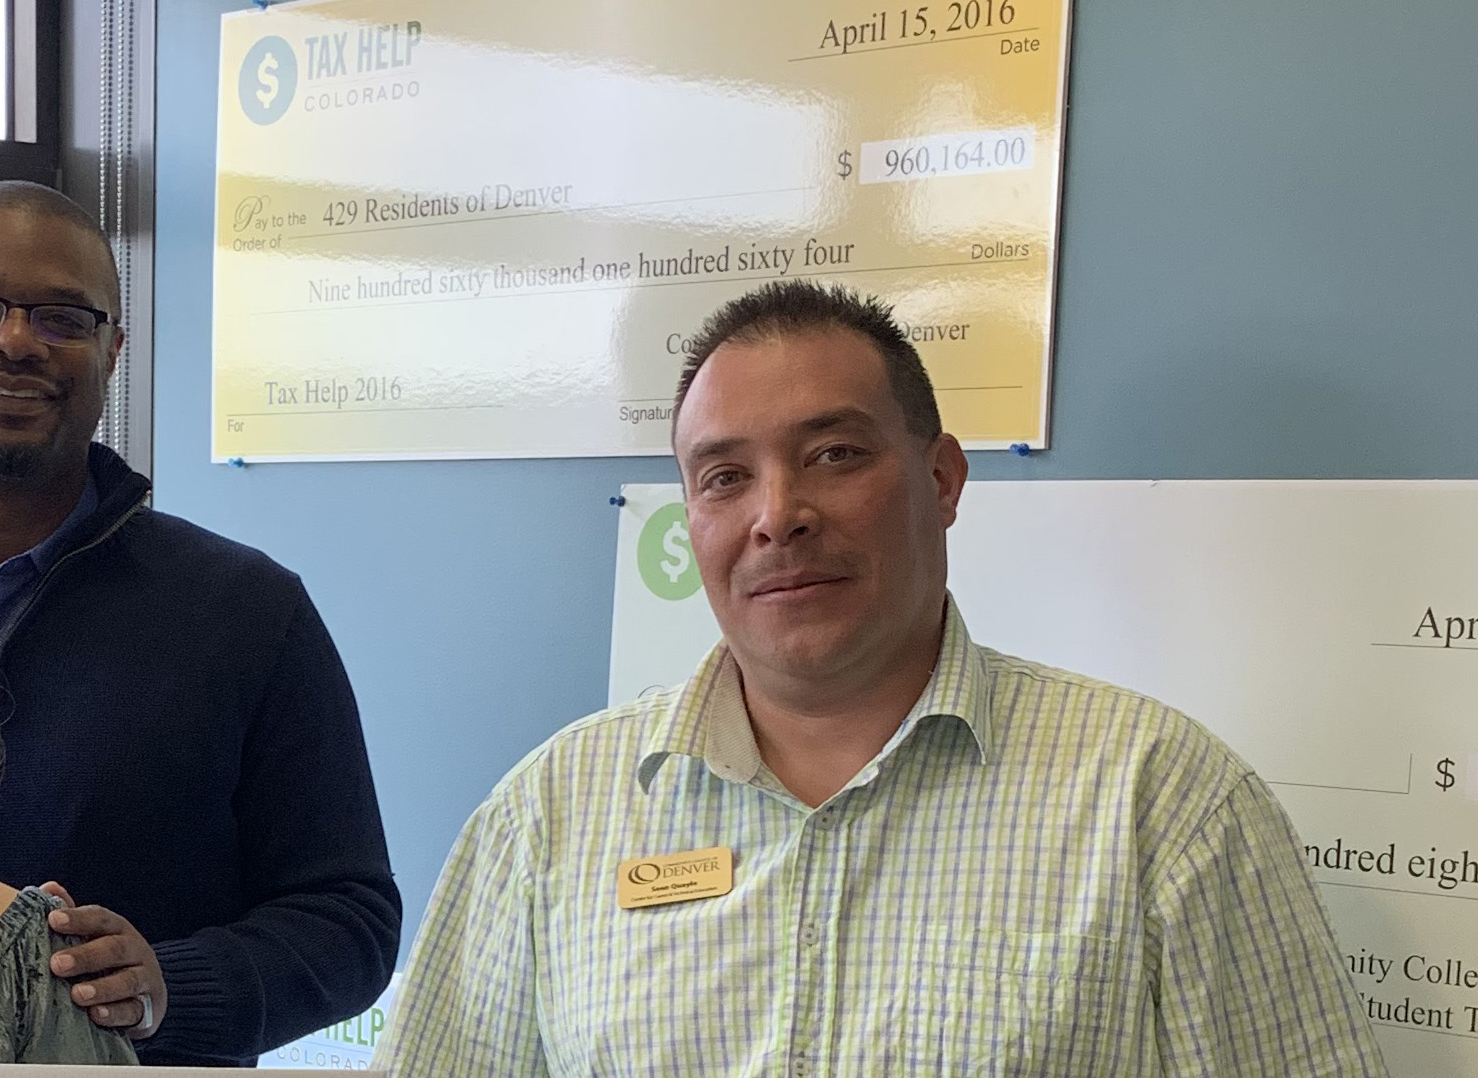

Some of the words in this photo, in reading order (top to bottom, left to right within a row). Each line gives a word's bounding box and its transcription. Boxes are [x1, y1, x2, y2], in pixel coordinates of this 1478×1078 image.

[819, 12, 888, 54] April
[899, 7, 937, 41] 15,
[946, 0, 1016, 33] 2016
[304, 36, 347, 80] TAX
[357, 20, 422, 74] HELP
[1000, 36, 1040, 56] Date
[304, 80, 421, 113] COLORADO
[837, 150, 853, 180] $
[885, 136, 1026, 178] 960,164.00
[233, 195, 270, 232] Pay
[271, 214, 285, 228] to
[287, 211, 307, 227] the
[323, 200, 358, 228] 429
[364, 192, 460, 224] Residents
[466, 185, 492, 213] of
[495, 183, 573, 209] Denver
[233, 237, 266, 252] Order
[269, 234, 282, 250] of
[970, 241, 1030, 260] Dollars
[308, 278, 351, 304] Nine
[356, 271, 433, 300] hundred
[438, 269, 488, 297] sixty
[493, 258, 586, 290] thousand
[593, 258, 631, 281] one
[638, 245, 730, 279] hundred
[737, 242, 795, 275] sixty
[803, 238, 855, 265] four
[265, 380, 299, 406] Tax
[304, 379, 349, 409] Help
[354, 376, 402, 402] 2016
[227, 419, 245, 433] For
[1435, 758, 1455, 792] $
[663, 861, 720, 878] DENVER
[1360, 992, 1454, 1030] tudent
